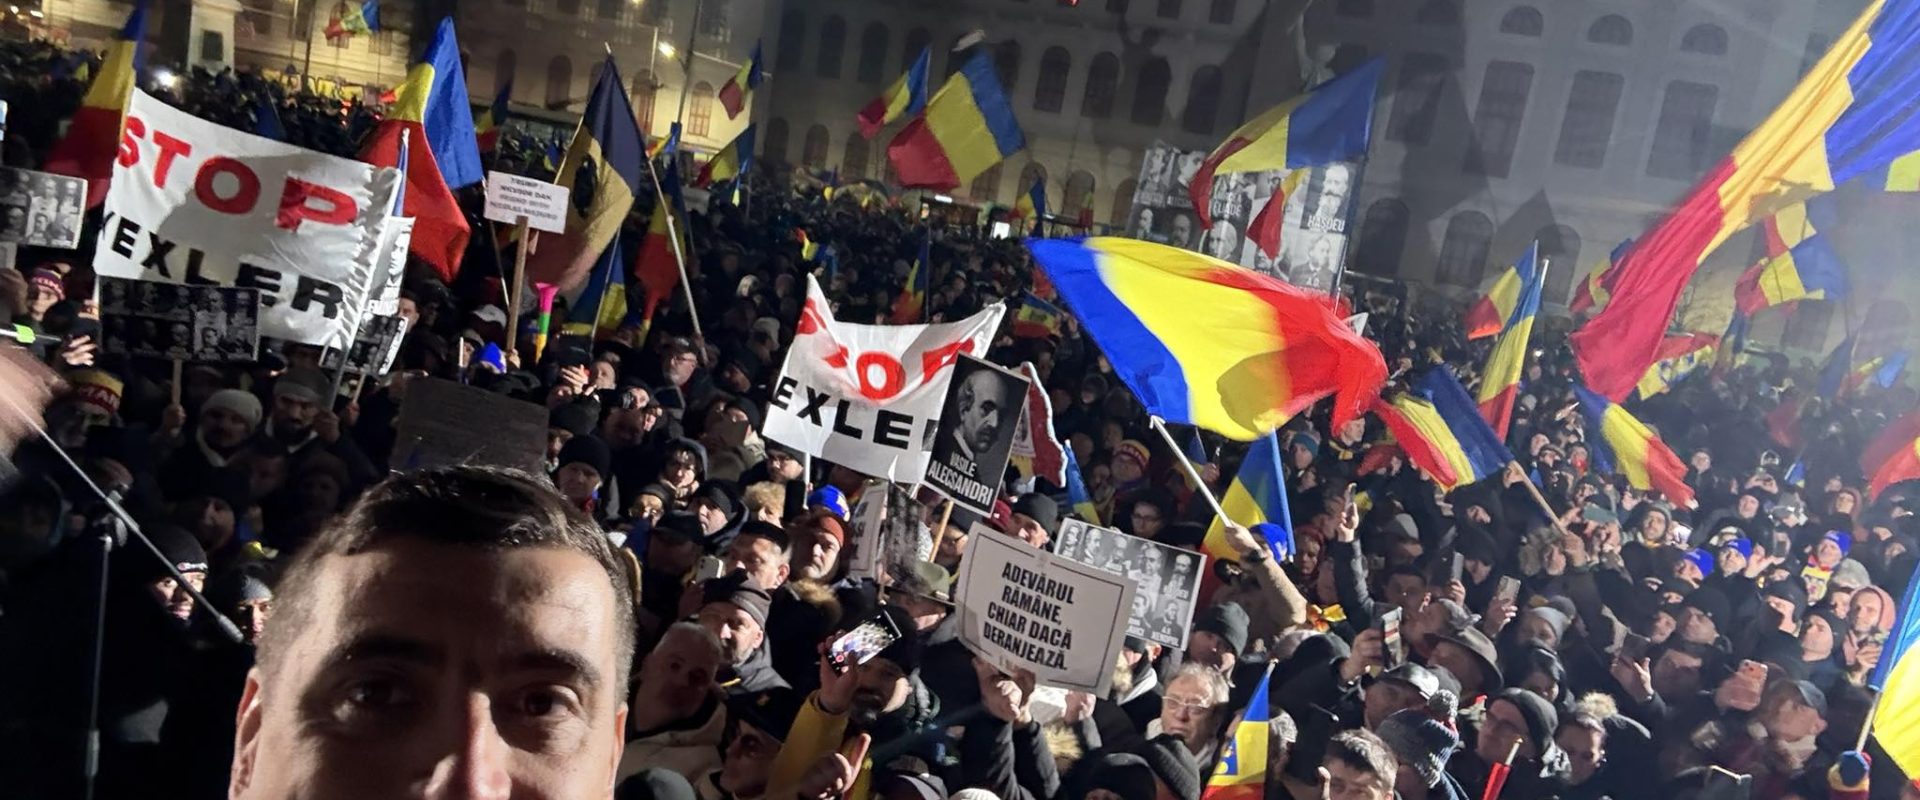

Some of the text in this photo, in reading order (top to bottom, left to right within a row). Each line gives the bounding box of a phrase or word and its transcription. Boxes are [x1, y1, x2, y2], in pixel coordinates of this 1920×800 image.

[119, 116, 358, 233] STOP
[927, 460, 994, 506] ALECSANDRI
[949, 451, 977, 477] VASILE
[1002, 562, 1074, 604] ADEVĂRUL
[1002, 585, 1062, 625] RĂMÂNE,
[983, 621, 1067, 671] DERANJEAZĂ.
[988, 602, 1072, 650] CHIAR DACĂ
